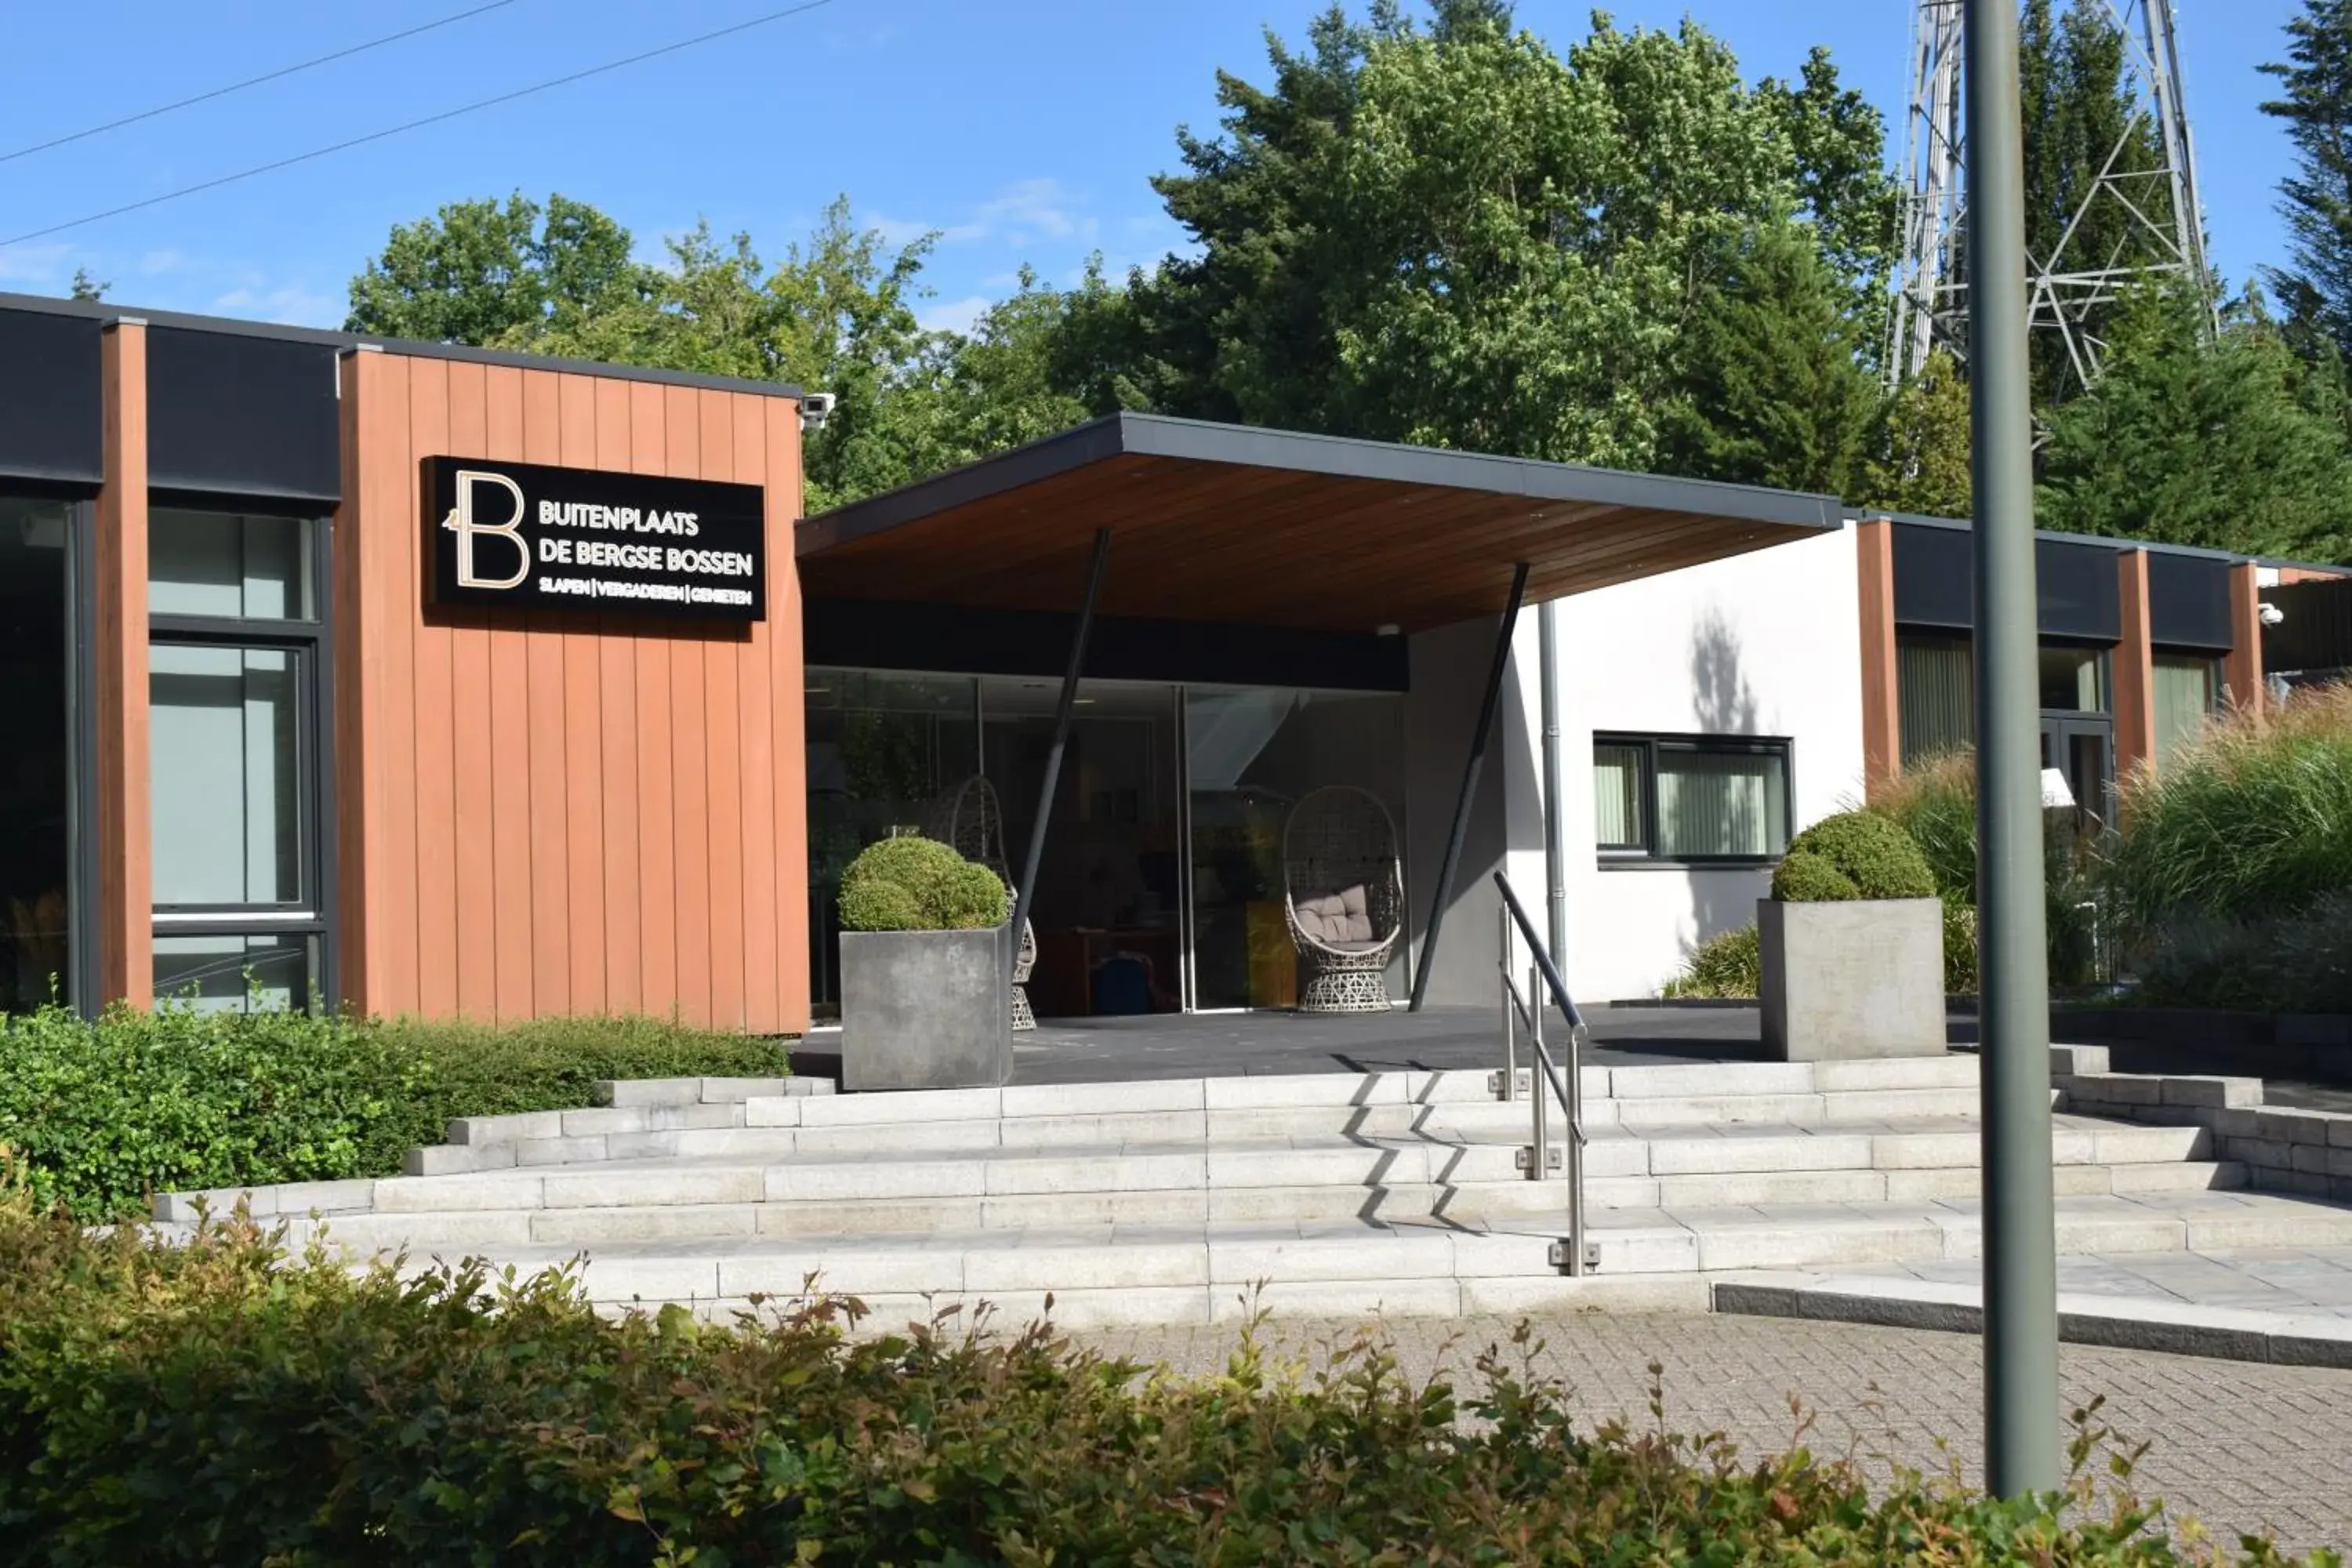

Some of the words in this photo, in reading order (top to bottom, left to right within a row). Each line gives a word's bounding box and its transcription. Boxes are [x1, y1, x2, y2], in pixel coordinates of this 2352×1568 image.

[455, 470, 531, 590] B
[539, 500, 699, 536] BUITENPLAATS
[539, 538, 572, 564] DE
[576, 541, 662, 571] BERGSE
[666, 548, 753, 577] BOSSEN
